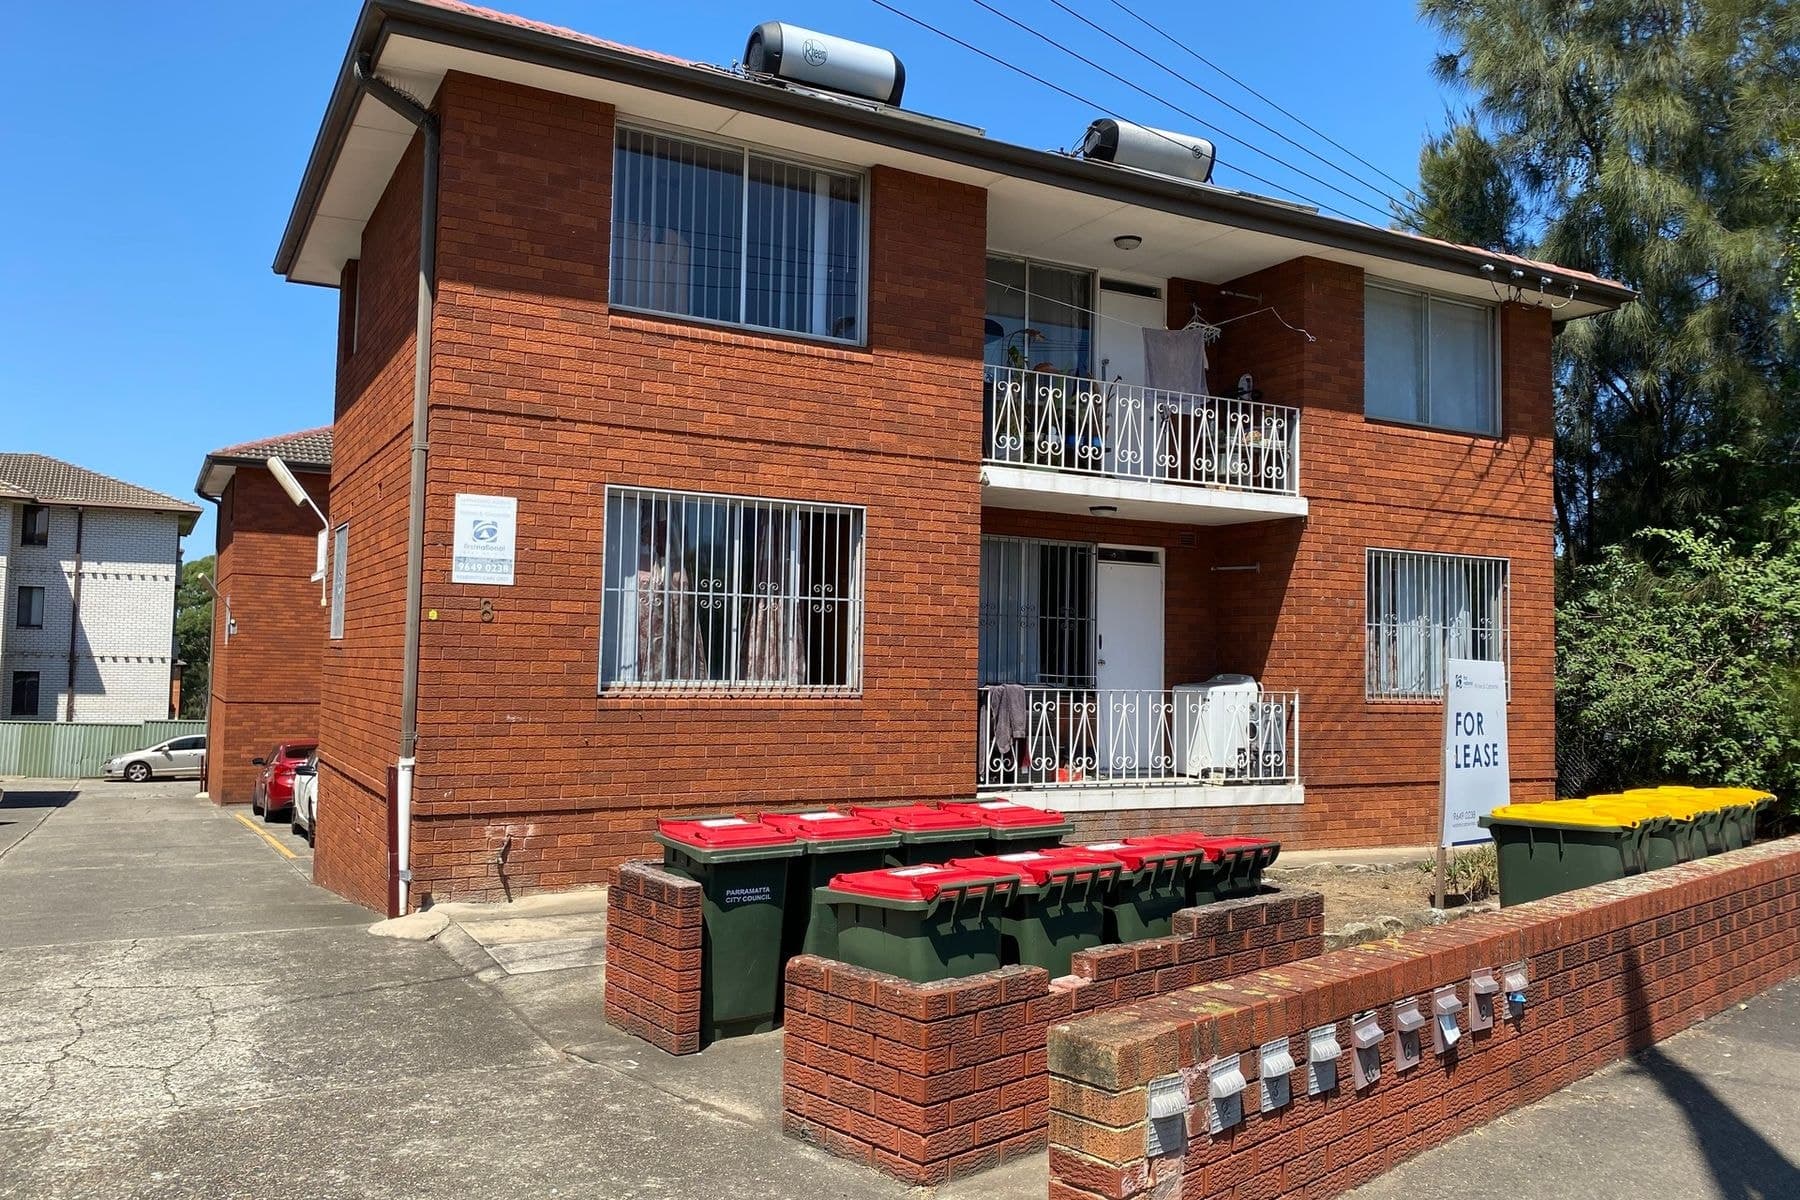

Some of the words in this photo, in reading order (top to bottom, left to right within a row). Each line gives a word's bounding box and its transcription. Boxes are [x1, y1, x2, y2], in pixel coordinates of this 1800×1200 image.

[804, 40, 827, 62] Rheem
[458, 562, 483, 571] 9649
[485, 564, 509, 573] 0238
[480, 597, 494, 623] 8
[1455, 711, 1485, 736] FOR
[1455, 743, 1499, 769] LEASE
[726, 886, 770, 896] PARRAMATTA
[742, 893, 772, 902] COUNCIL
[1405, 1042, 1412, 1061] 6
[1221, 1101, 1231, 1119] 2
